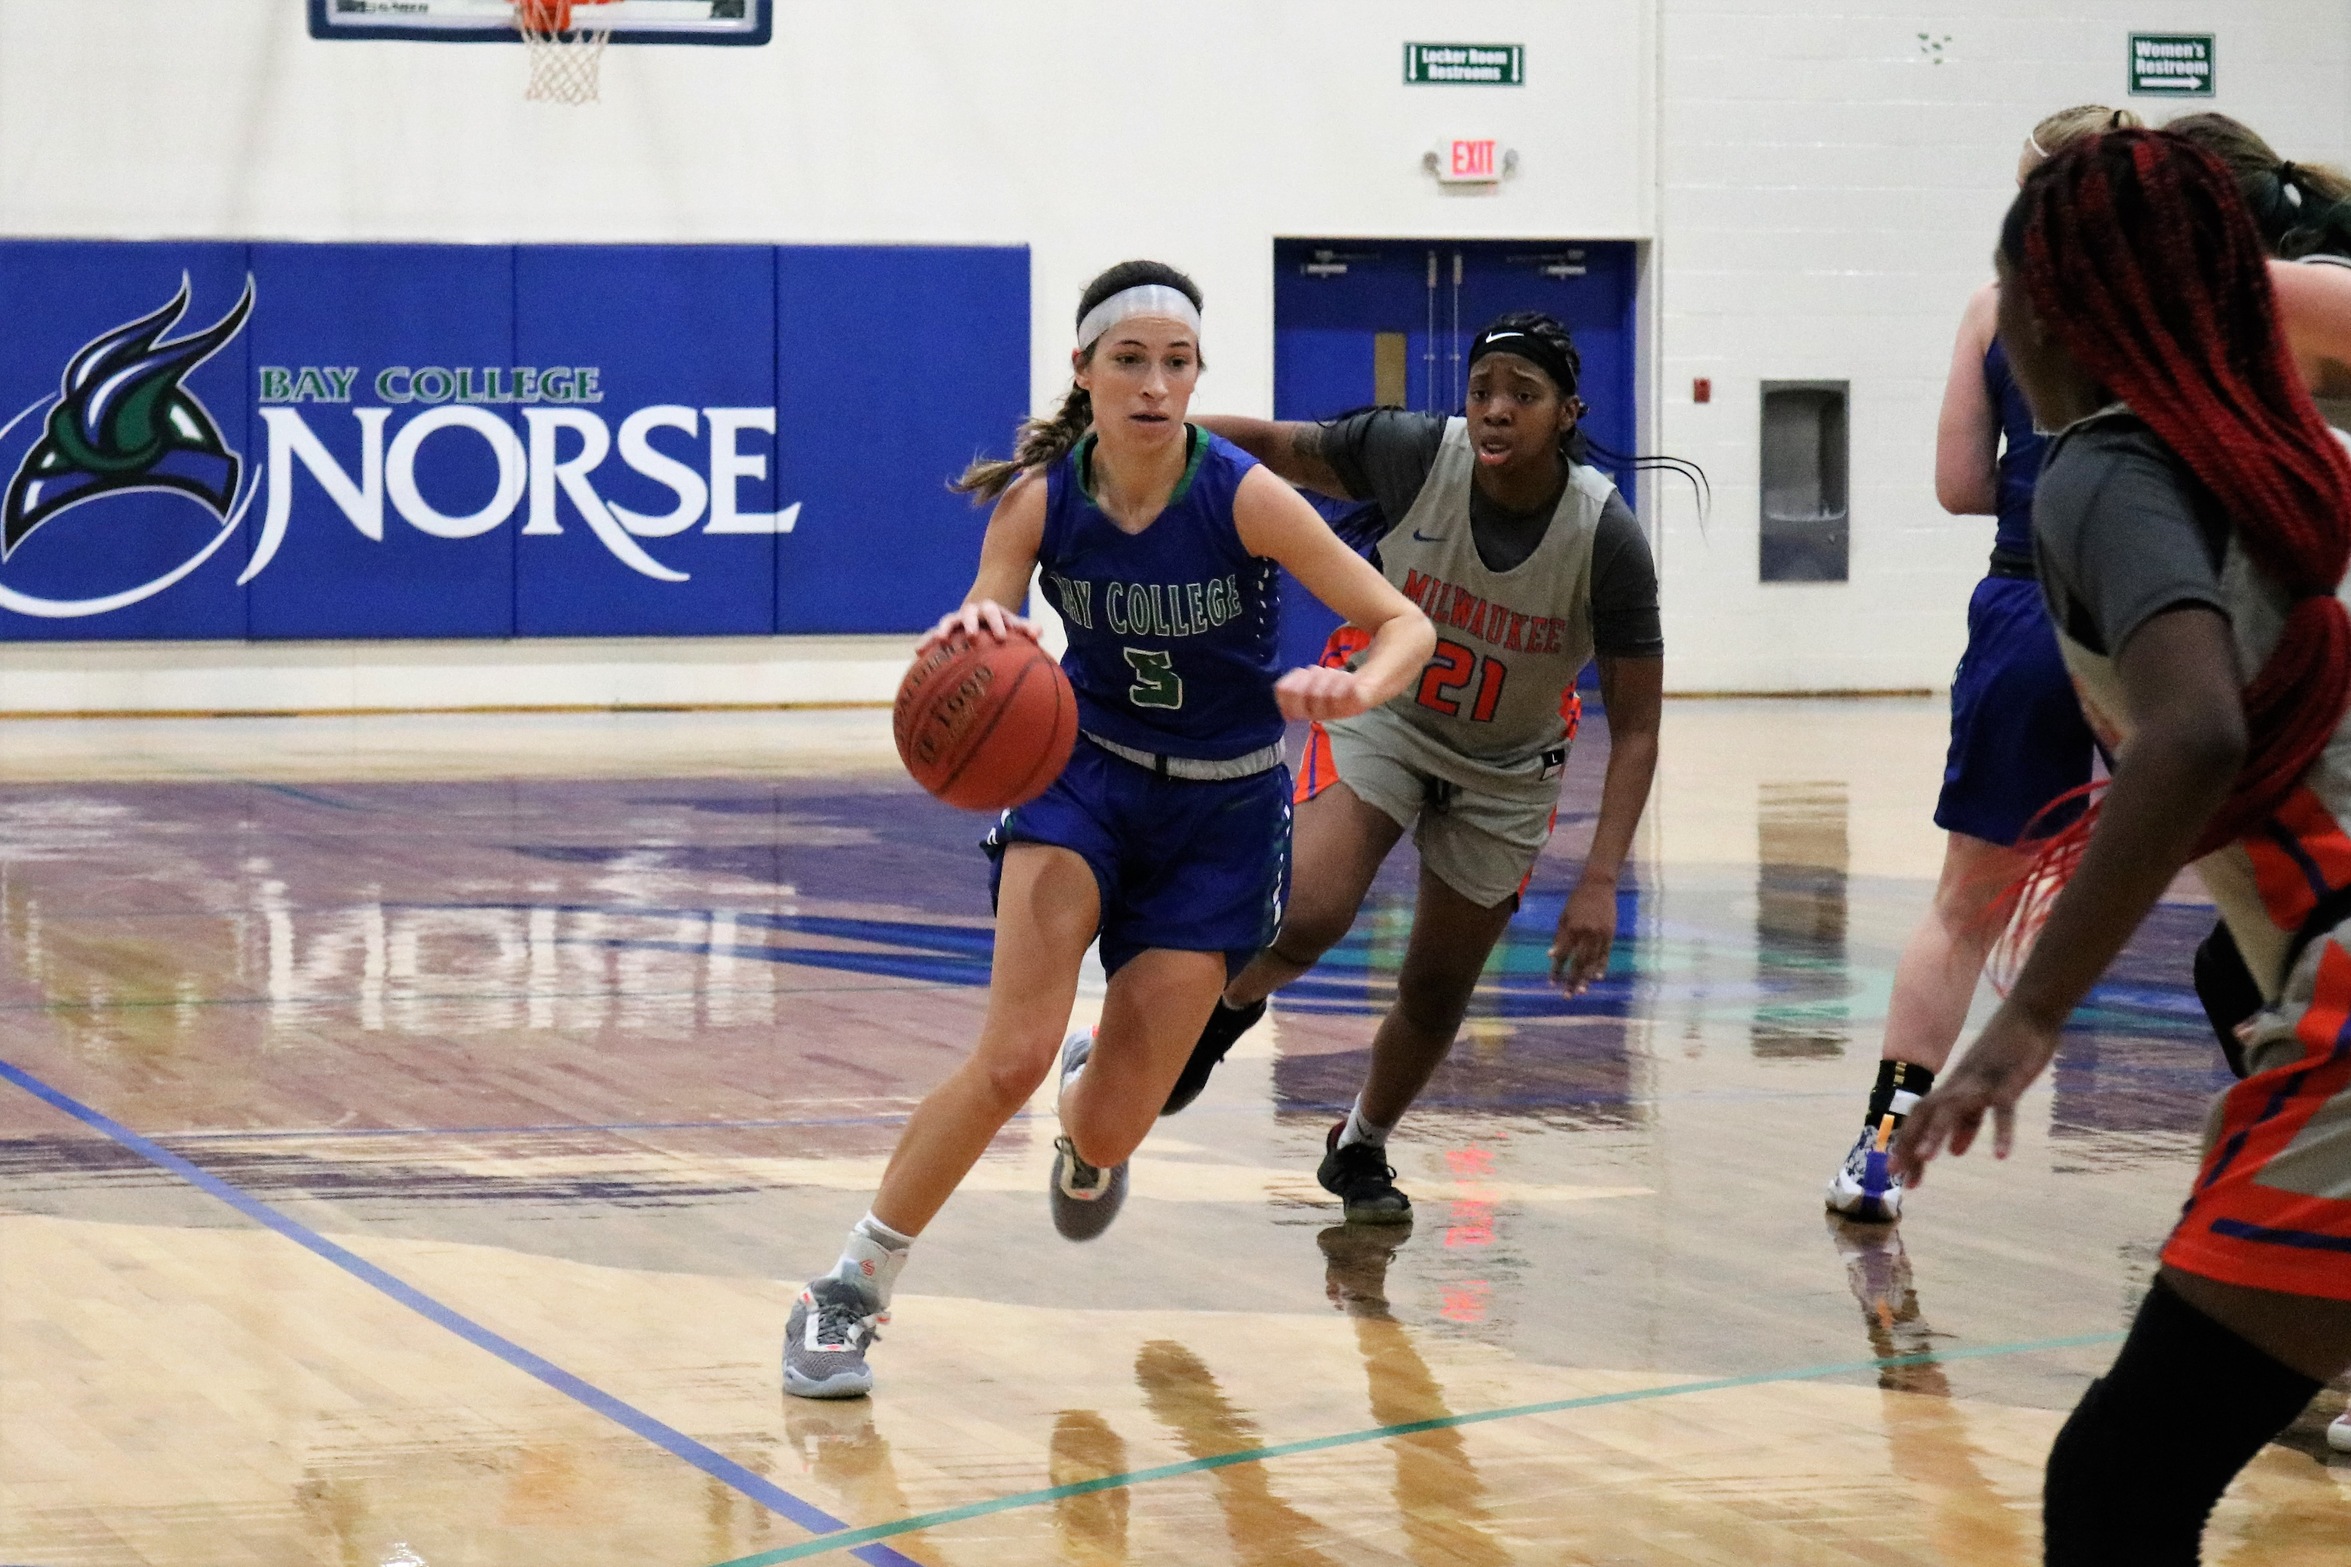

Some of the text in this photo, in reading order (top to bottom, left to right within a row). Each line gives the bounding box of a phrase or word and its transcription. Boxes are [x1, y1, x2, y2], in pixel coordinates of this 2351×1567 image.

[1422, 48, 1507, 64] Locker Room
[2136, 41, 2205, 58] Women's
[2136, 58, 2208, 75] Restroom
[1428, 65, 1500, 80] Restrooms
[1451, 139, 1497, 176] EXIT
[258, 366, 604, 403] BAY COLLEGE
[236, 404, 802, 586] NORSE
[1106, 574, 1243, 637] COLLEGE
[1402, 568, 1566, 654] MILWAUKEE
[1415, 637, 1508, 723] 21
[1551, 753, 1558, 764] L
